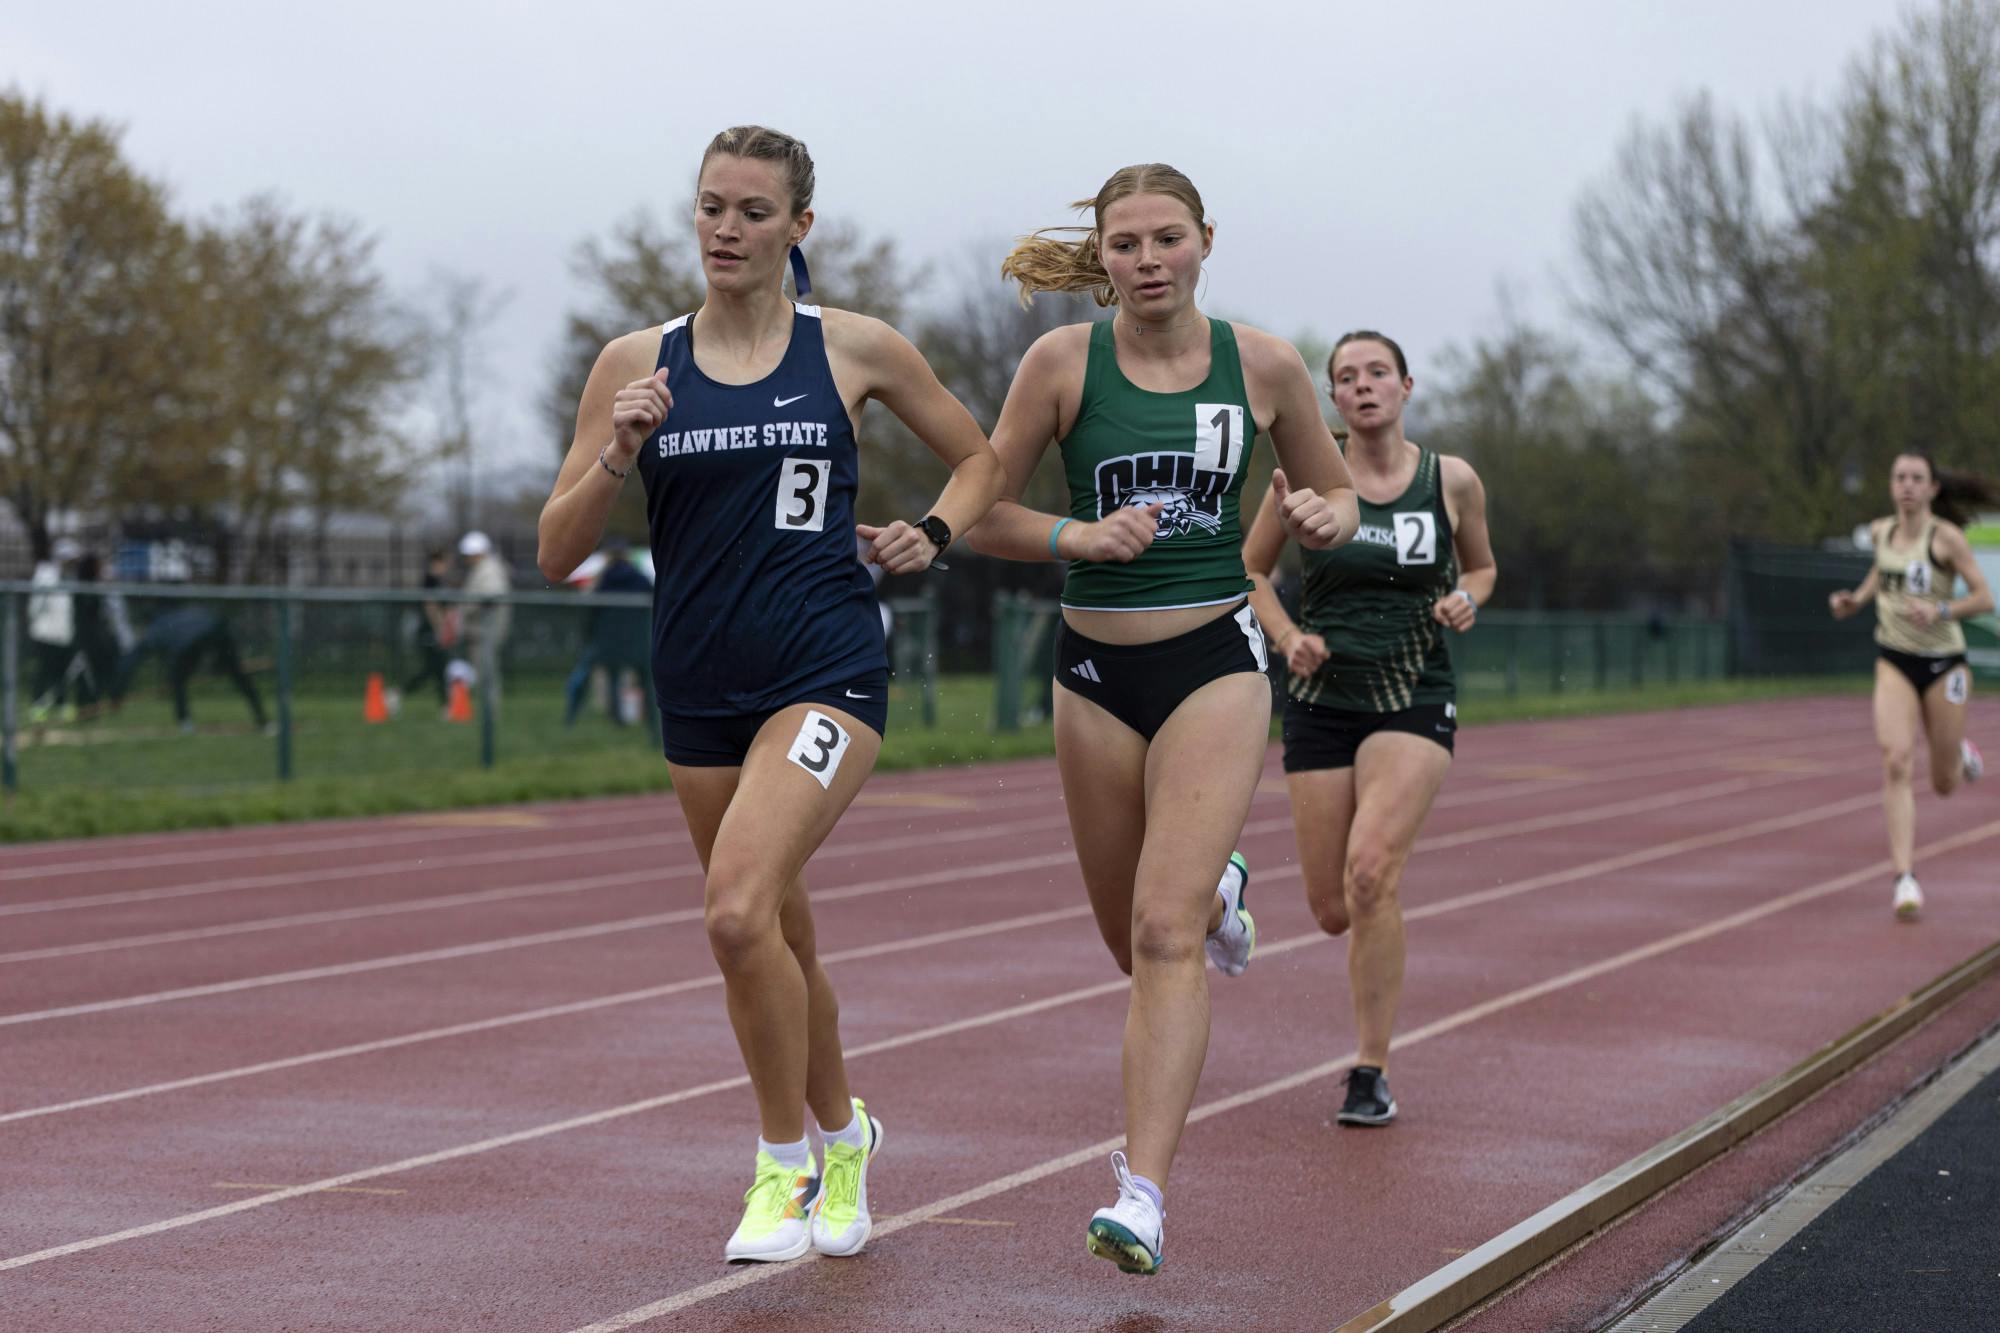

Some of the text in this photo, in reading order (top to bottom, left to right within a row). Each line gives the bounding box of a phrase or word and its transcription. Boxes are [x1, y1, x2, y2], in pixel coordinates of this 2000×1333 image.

[659, 422, 828, 458] SHAWNEE STATE
[1210, 408, 1231, 469] 1
[786, 463, 819, 526] 3
[1403, 516, 1427, 560] 2
[800, 719, 839, 772] 3
